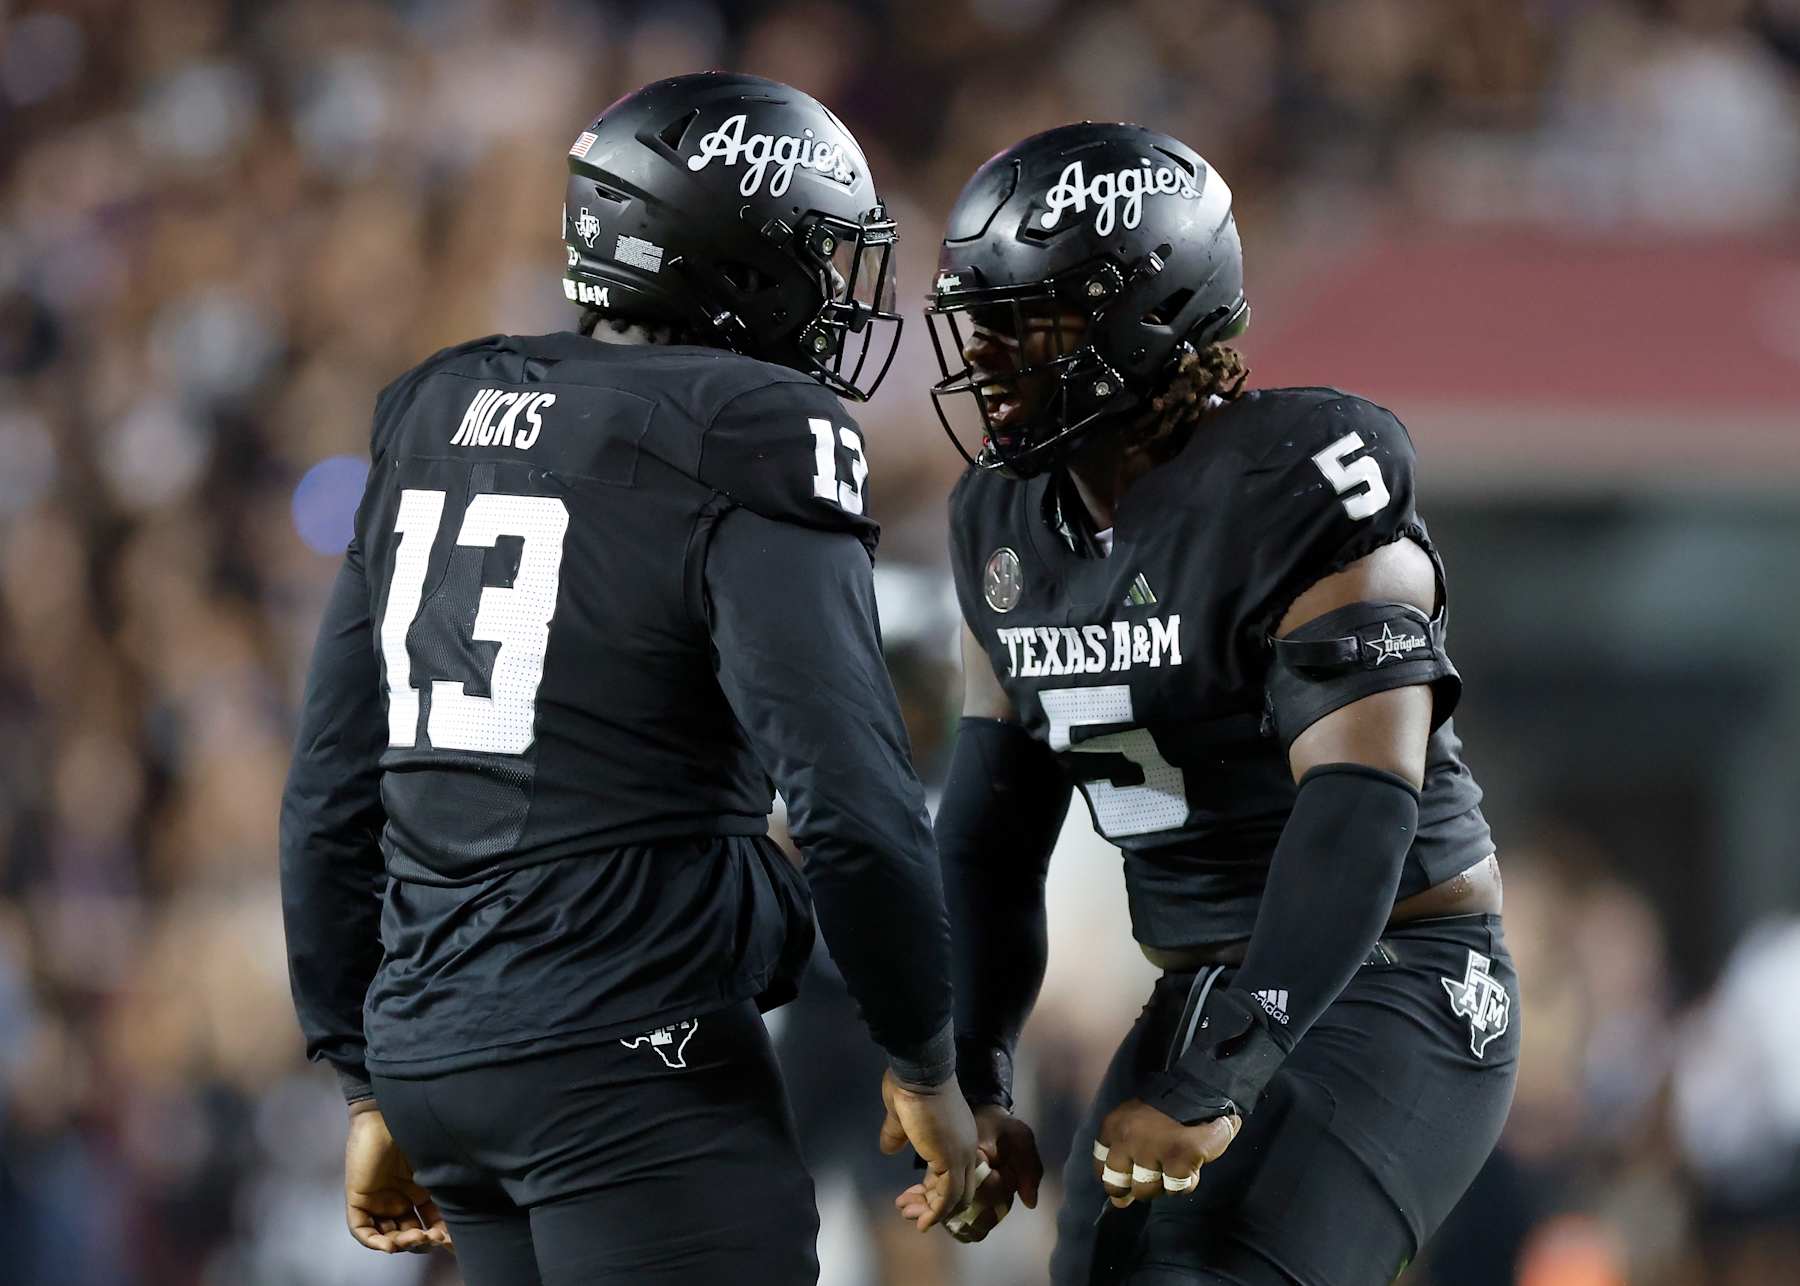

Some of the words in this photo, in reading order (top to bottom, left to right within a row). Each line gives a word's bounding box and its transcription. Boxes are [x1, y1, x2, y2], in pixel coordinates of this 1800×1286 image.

[687, 115, 853, 197] Aggies
[1040, 160, 1203, 236] Aggies
[449, 388, 557, 450] HICKS
[807, 417, 869, 516] 13
[1311, 430, 1391, 522] 5
[381, 489, 570, 755] 13
[996, 624, 1107, 678] TEXAS
[1109, 614, 1182, 671] A&M
[1385, 634, 1427, 653] Douglas
[1037, 684, 1191, 838] 5
